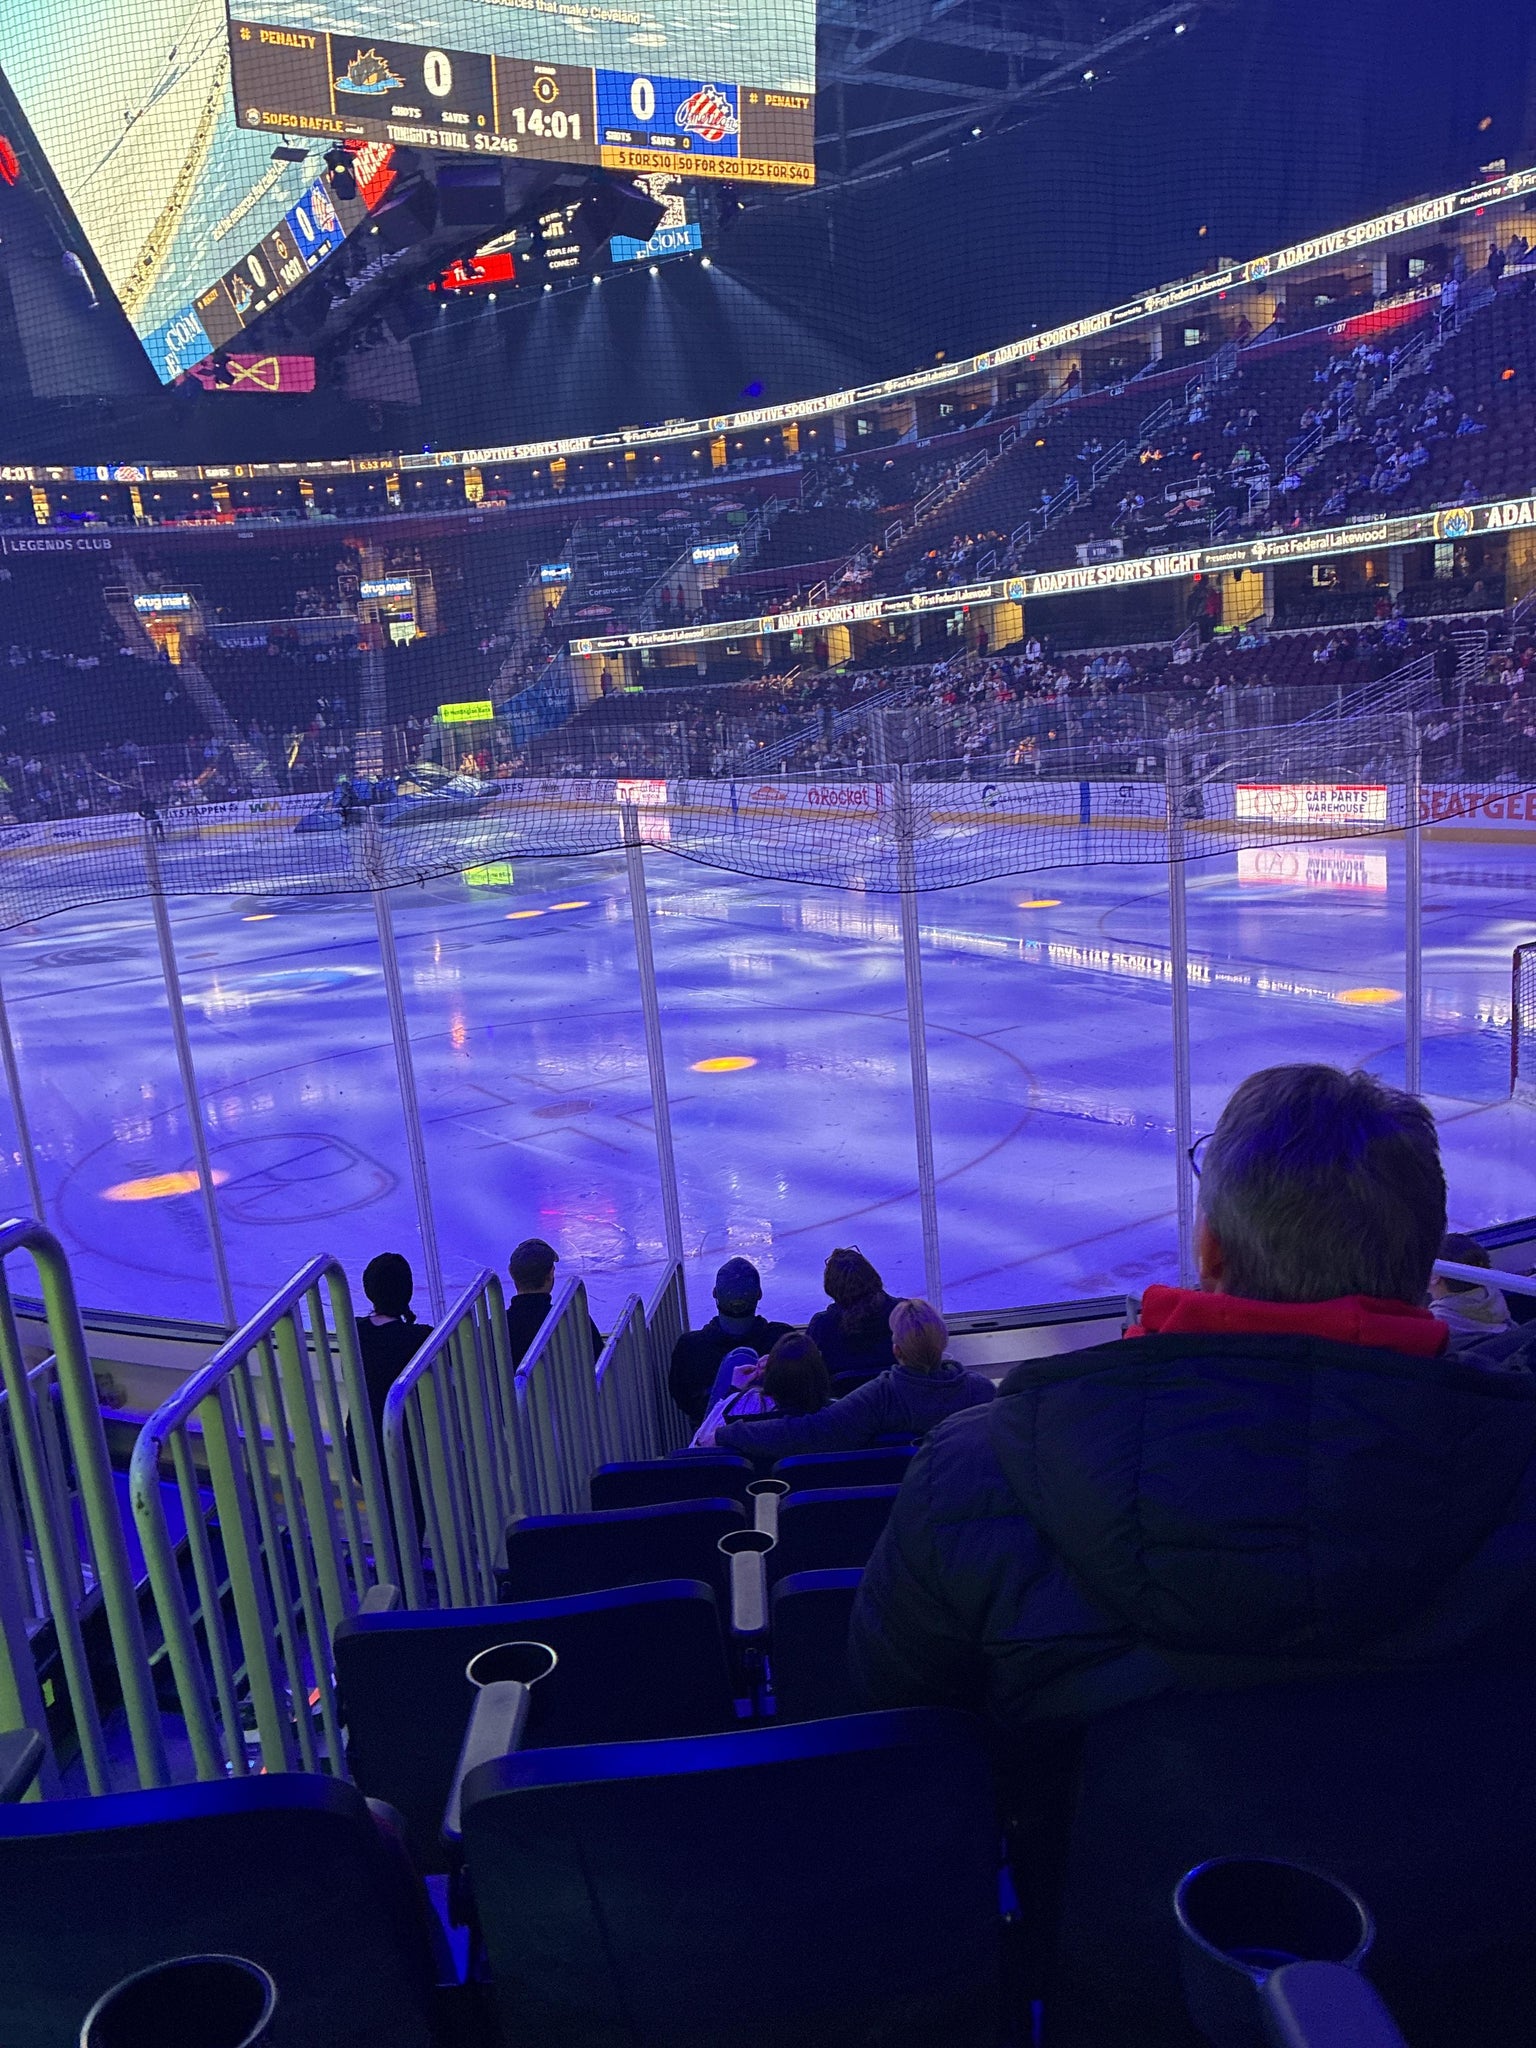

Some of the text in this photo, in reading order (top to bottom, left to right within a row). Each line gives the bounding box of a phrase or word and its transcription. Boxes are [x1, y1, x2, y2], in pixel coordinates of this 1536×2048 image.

[536, 0, 557, 13] that
[558, 4, 589, 17] make
[590, 7, 641, 26] Cleveland
[260, 30, 316, 49] PENALTY
[423, 51, 452, 96] 0
[630, 78, 655, 121] 0
[765, 94, 810, 109] PENALTY
[262, 112, 298, 127] 50/50
[299, 116, 344, 132] RAFFLE
[441, 111, 470, 124] SAVES
[512, 107, 581, 140] 14:01
[439, 131, 470, 148] TOTAL
[474, 133, 519, 153] $1,246
[619, 151, 671, 168] 5 FOR $10
[679, 158, 739, 174] 50 FOR $20
[747, 163, 810, 179] 125 FOR $40
[1277, 233, 1345, 269] ADAPTIVE
[1346, 213, 1406, 245] SPORTS
[1407, 197, 1456, 226] NIGHT
[995, 338, 1039, 364] ADAPTIVE
[1040, 325, 1079, 347] SPORTS
[1080, 312, 1112, 335] NIGHT
[1155, 295, 1169, 306] First
[1170, 285, 1195, 302] Federal
[1195, 273, 1232, 295] Lakewood
[734, 408, 784, 426] ADAPTIVE
[785, 399, 825, 417] SPORTS
[826, 391, 856, 408] NIGHT
[462, 449, 515, 463] ADAPTIVE
[516, 444, 559, 458] SPORTS
[560, 439, 592, 453] NIGHT
[0, 466, 33, 481] 4:01
[1487, 501, 1536, 528] ADA
[11, 538, 112, 551] LEGENDS CLUB
[693, 544, 740, 560] drug mart
[1033, 526, 1387, 593] ADAPTIVE SPORTS NIGHT Presented by First Federal Lakewood
[361, 581, 412, 596] drug mart
[134, 595, 190, 610] drug mart
[778, 611, 818, 629] ADAPTIVE
[819, 605, 853, 623] SPORTS
[854, 601, 883, 619] NIGHT
[921, 596, 935, 606] First
[936, 590, 958, 604] Federal
[958, 586, 991, 601] Lakewood
[638, 635, 652, 645] First
[653, 632, 676, 643] Federal
[676, 629, 704, 641] Lakewood
[821, 787, 868, 806] Rocket
[1306, 791, 1368, 802] CAR PARTS
[186, 806, 227, 817] HAPPEN
[1307, 803, 1365, 814] WAREHOUSE
